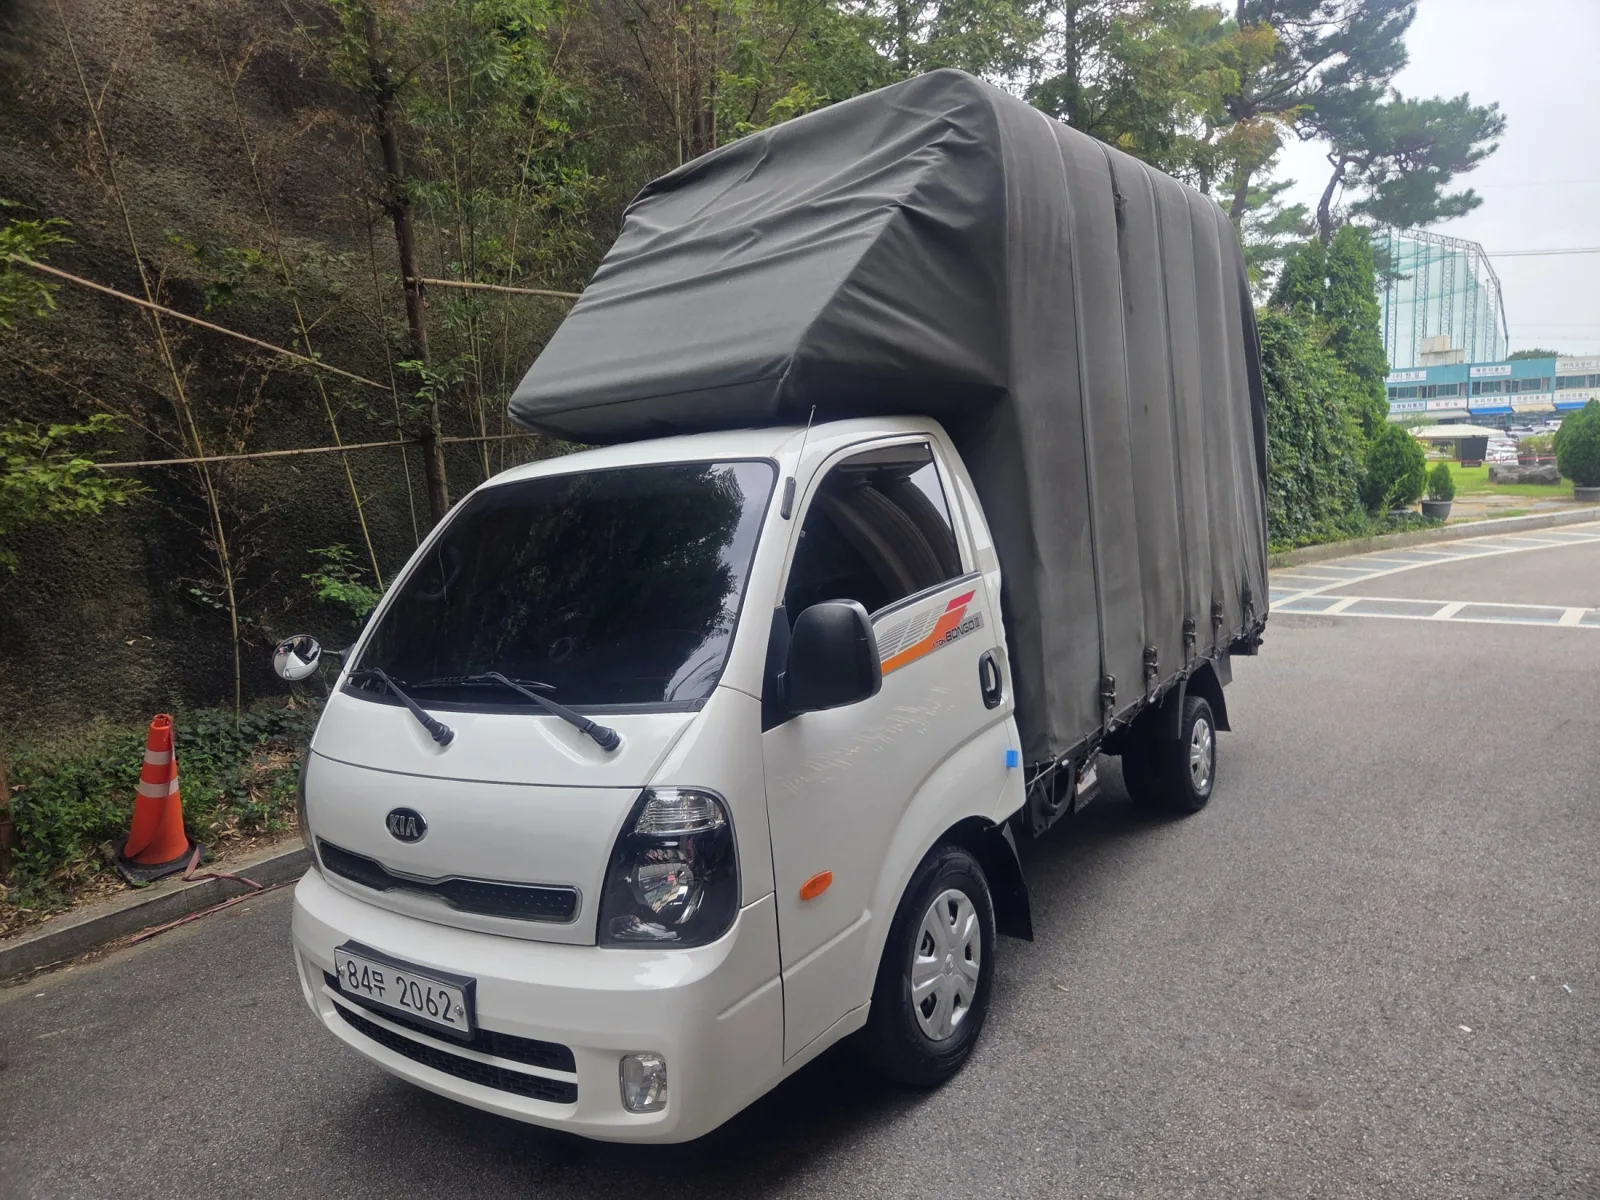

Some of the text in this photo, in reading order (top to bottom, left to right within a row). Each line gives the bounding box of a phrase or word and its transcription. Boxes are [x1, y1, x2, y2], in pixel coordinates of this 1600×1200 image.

[945, 619, 975, 642] BONGO
[389, 813, 419, 837] KIA
[347, 960, 455, 1023] 84무 2062
